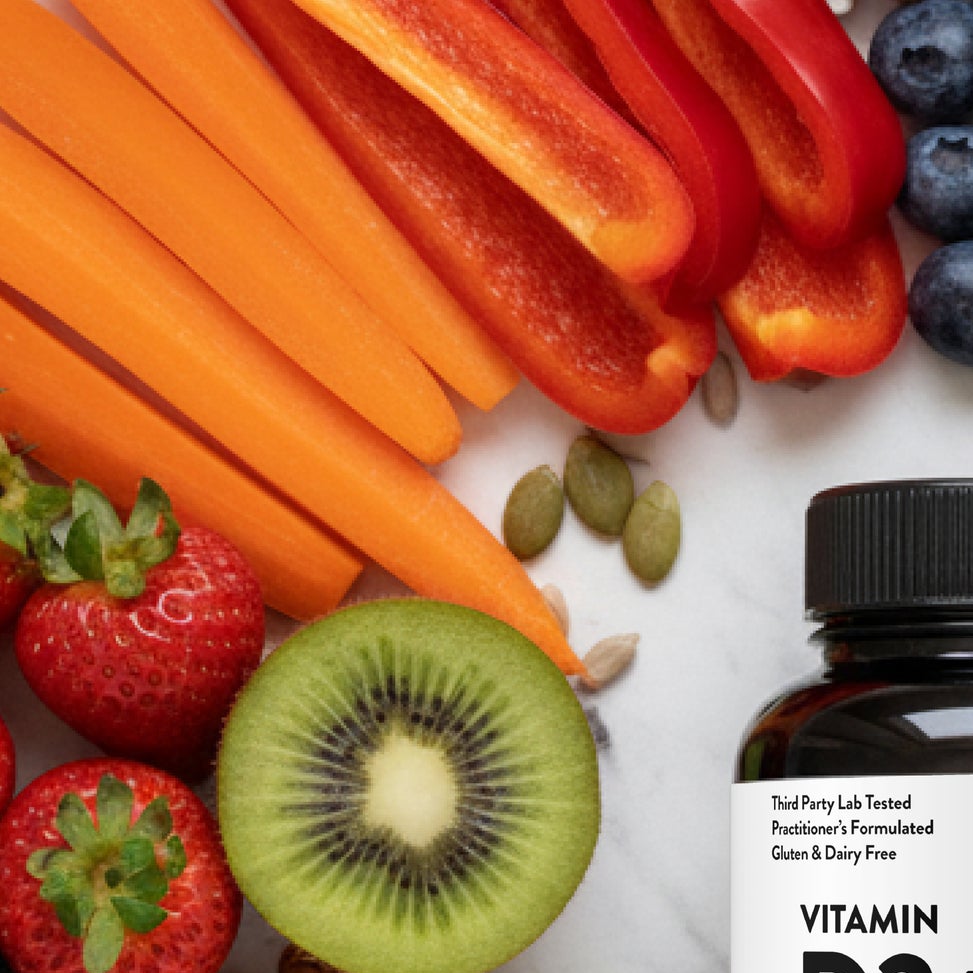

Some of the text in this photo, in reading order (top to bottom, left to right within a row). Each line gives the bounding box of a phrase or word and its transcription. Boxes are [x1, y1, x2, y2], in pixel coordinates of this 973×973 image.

[772, 794, 912, 813] Third Party Lab Tested
[851, 819, 934, 836] Formulated
[771, 844, 897, 865] Gluten & Dairy Free
[799, 903, 938, 935] VITAMIN
